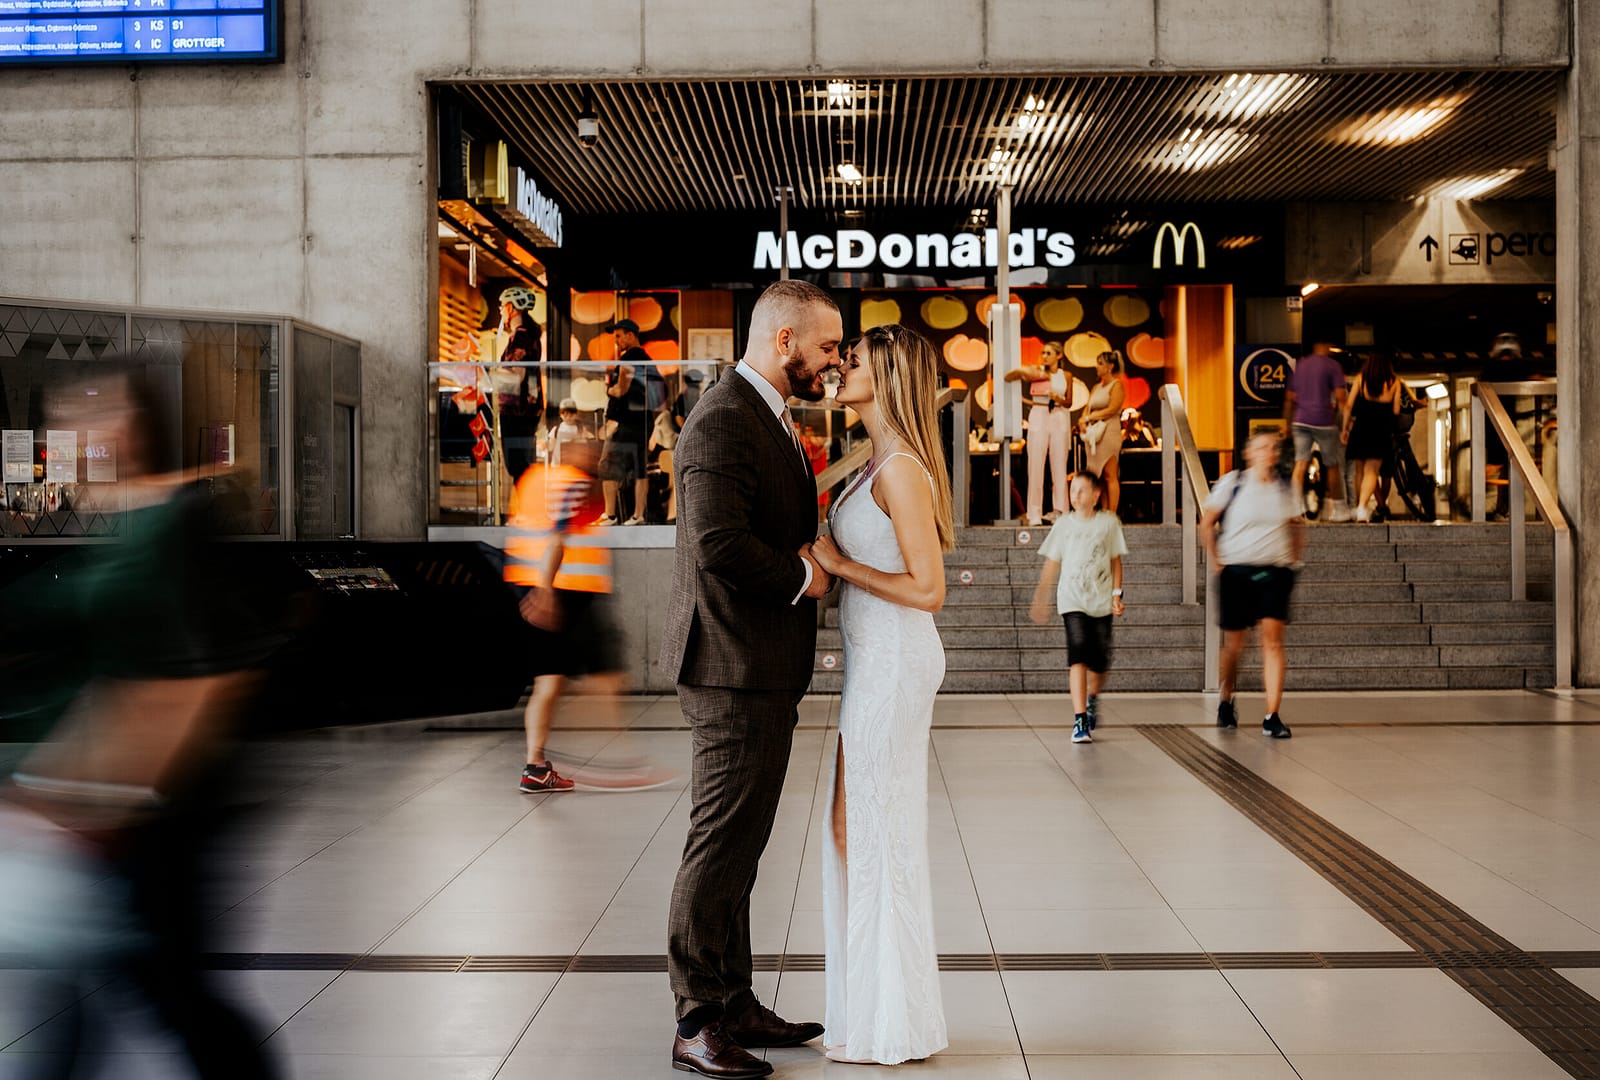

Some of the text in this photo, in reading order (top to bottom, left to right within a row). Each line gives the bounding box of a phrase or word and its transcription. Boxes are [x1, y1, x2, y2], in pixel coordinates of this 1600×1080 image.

[134, 20, 184, 31] 3 KS S1
[134, 38, 225, 49] 4 IC GROTTGER
[752, 227, 1076, 270] McDonald's
[1260, 364, 1286, 382] 24
